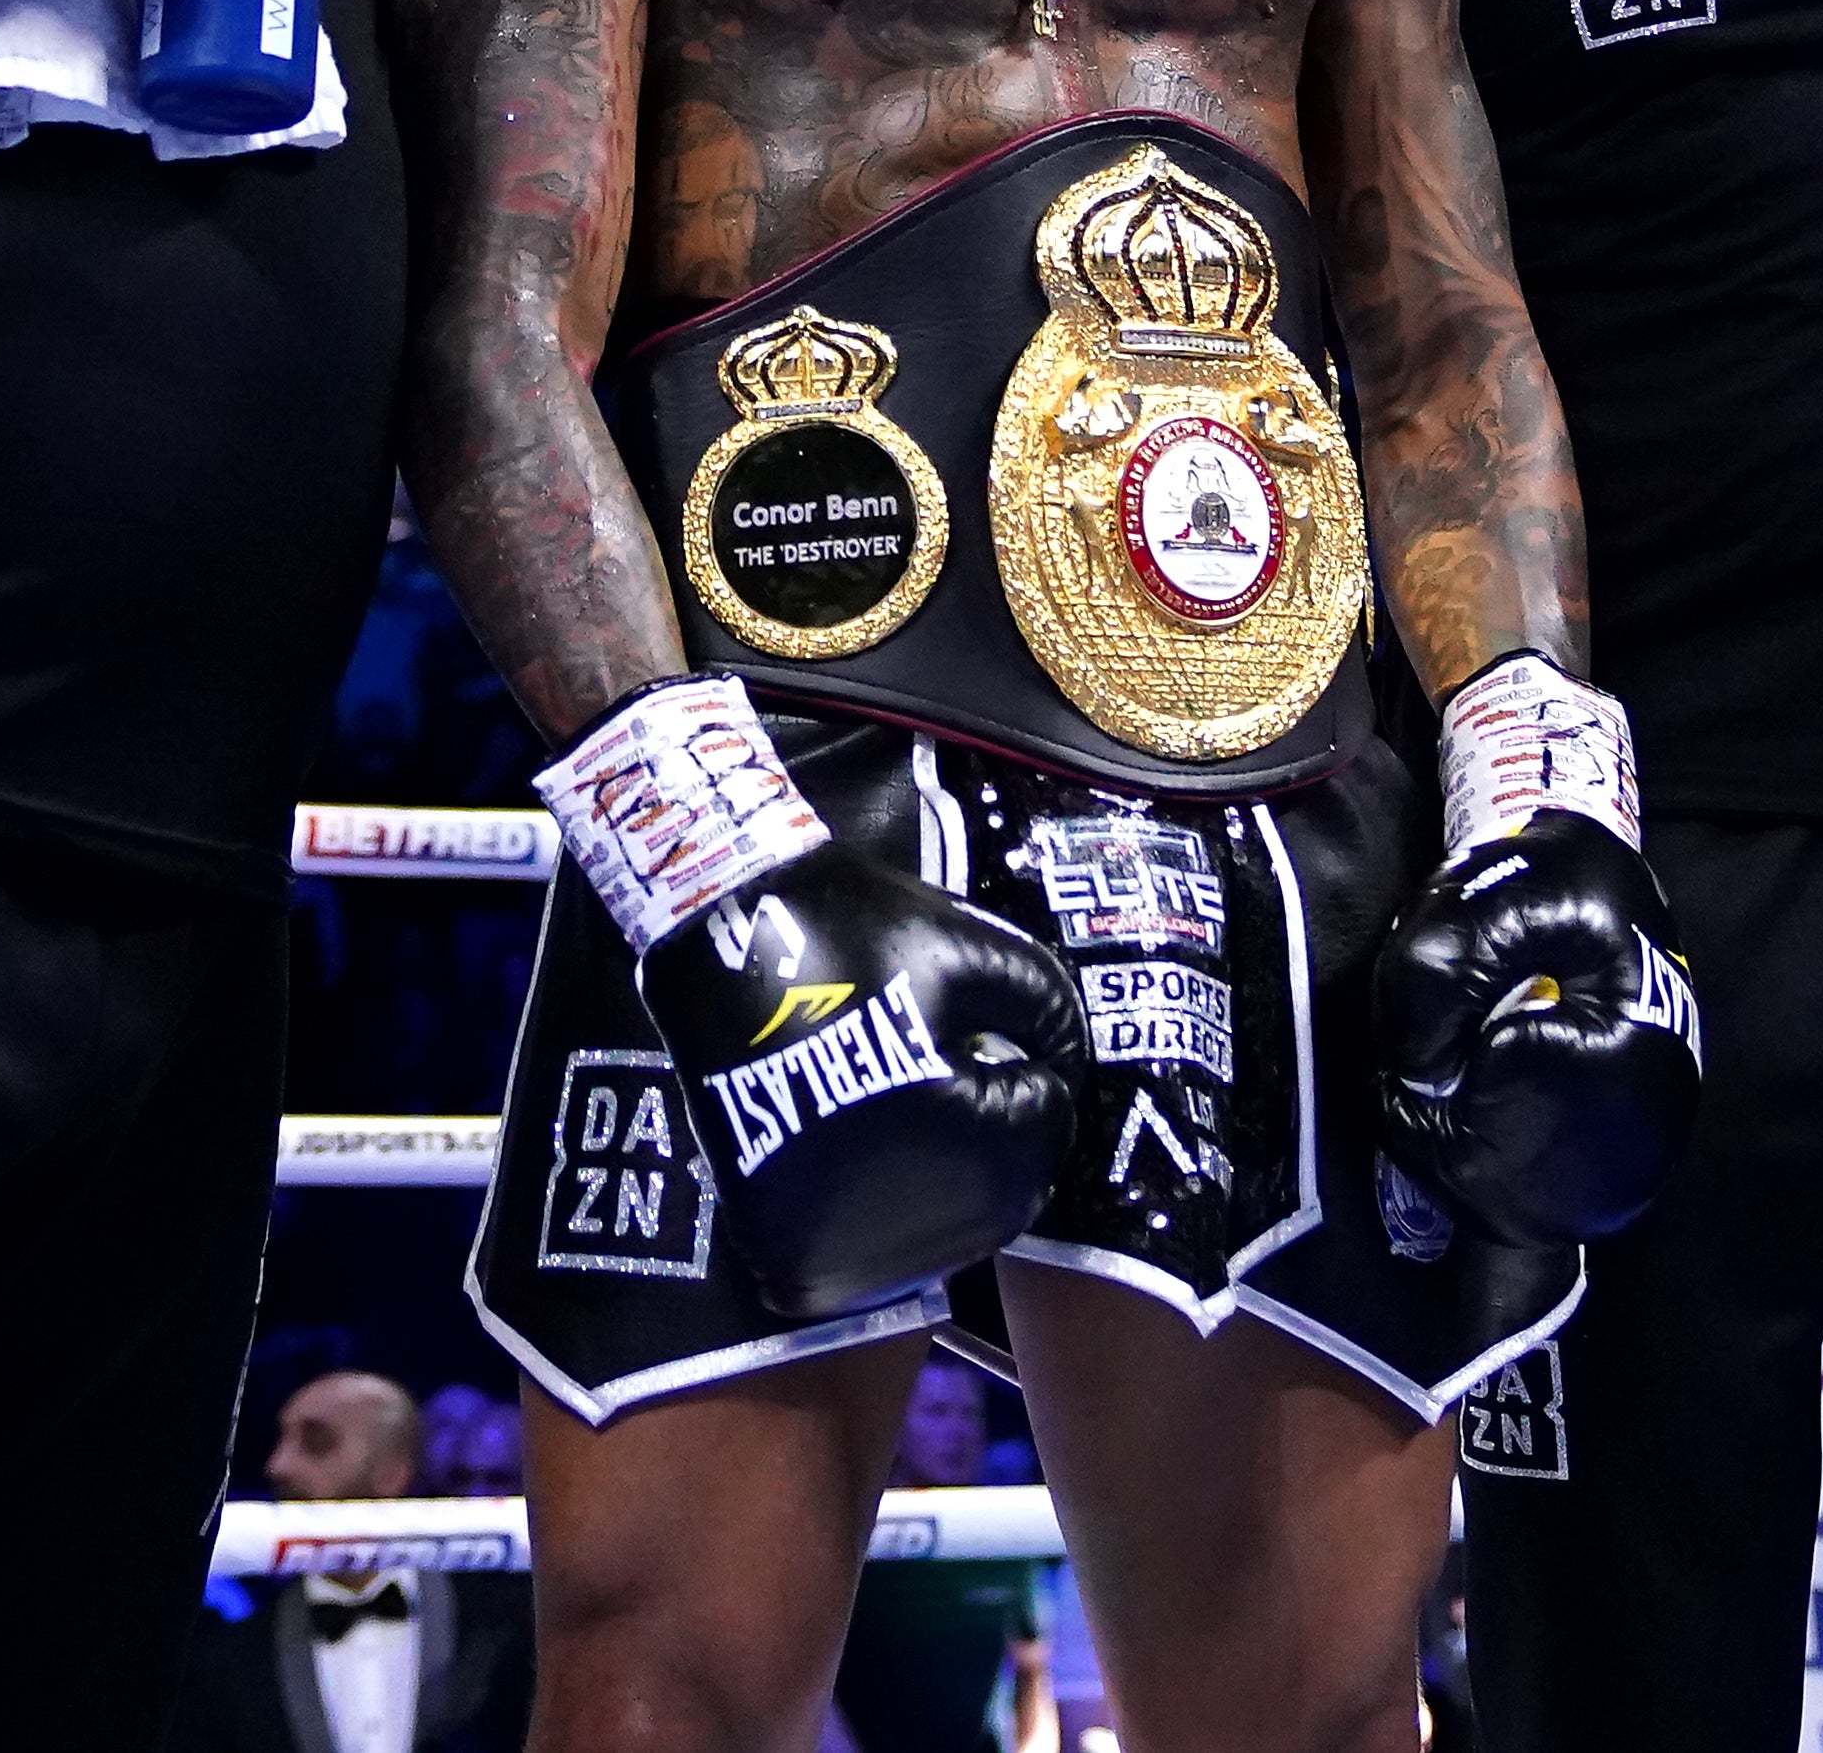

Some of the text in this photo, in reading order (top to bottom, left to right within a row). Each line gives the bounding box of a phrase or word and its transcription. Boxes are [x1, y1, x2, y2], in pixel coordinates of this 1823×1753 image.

[733, 494, 898, 529] Conor Benn
[733, 535, 902, 568] THE 'DESTROYER'
[312, 816, 536, 860] BETFRED
[1040, 856, 1226, 924] ELITE
[1100, 970, 1226, 1022] SPORTS
[1110, 1020, 1226, 1073] DIRECT
[710, 969, 955, 1178] EVERLAST
[581, 1086, 672, 1158] DA
[568, 1166, 664, 1239] ZN
[1469, 1404, 1533, 1456] ZN
